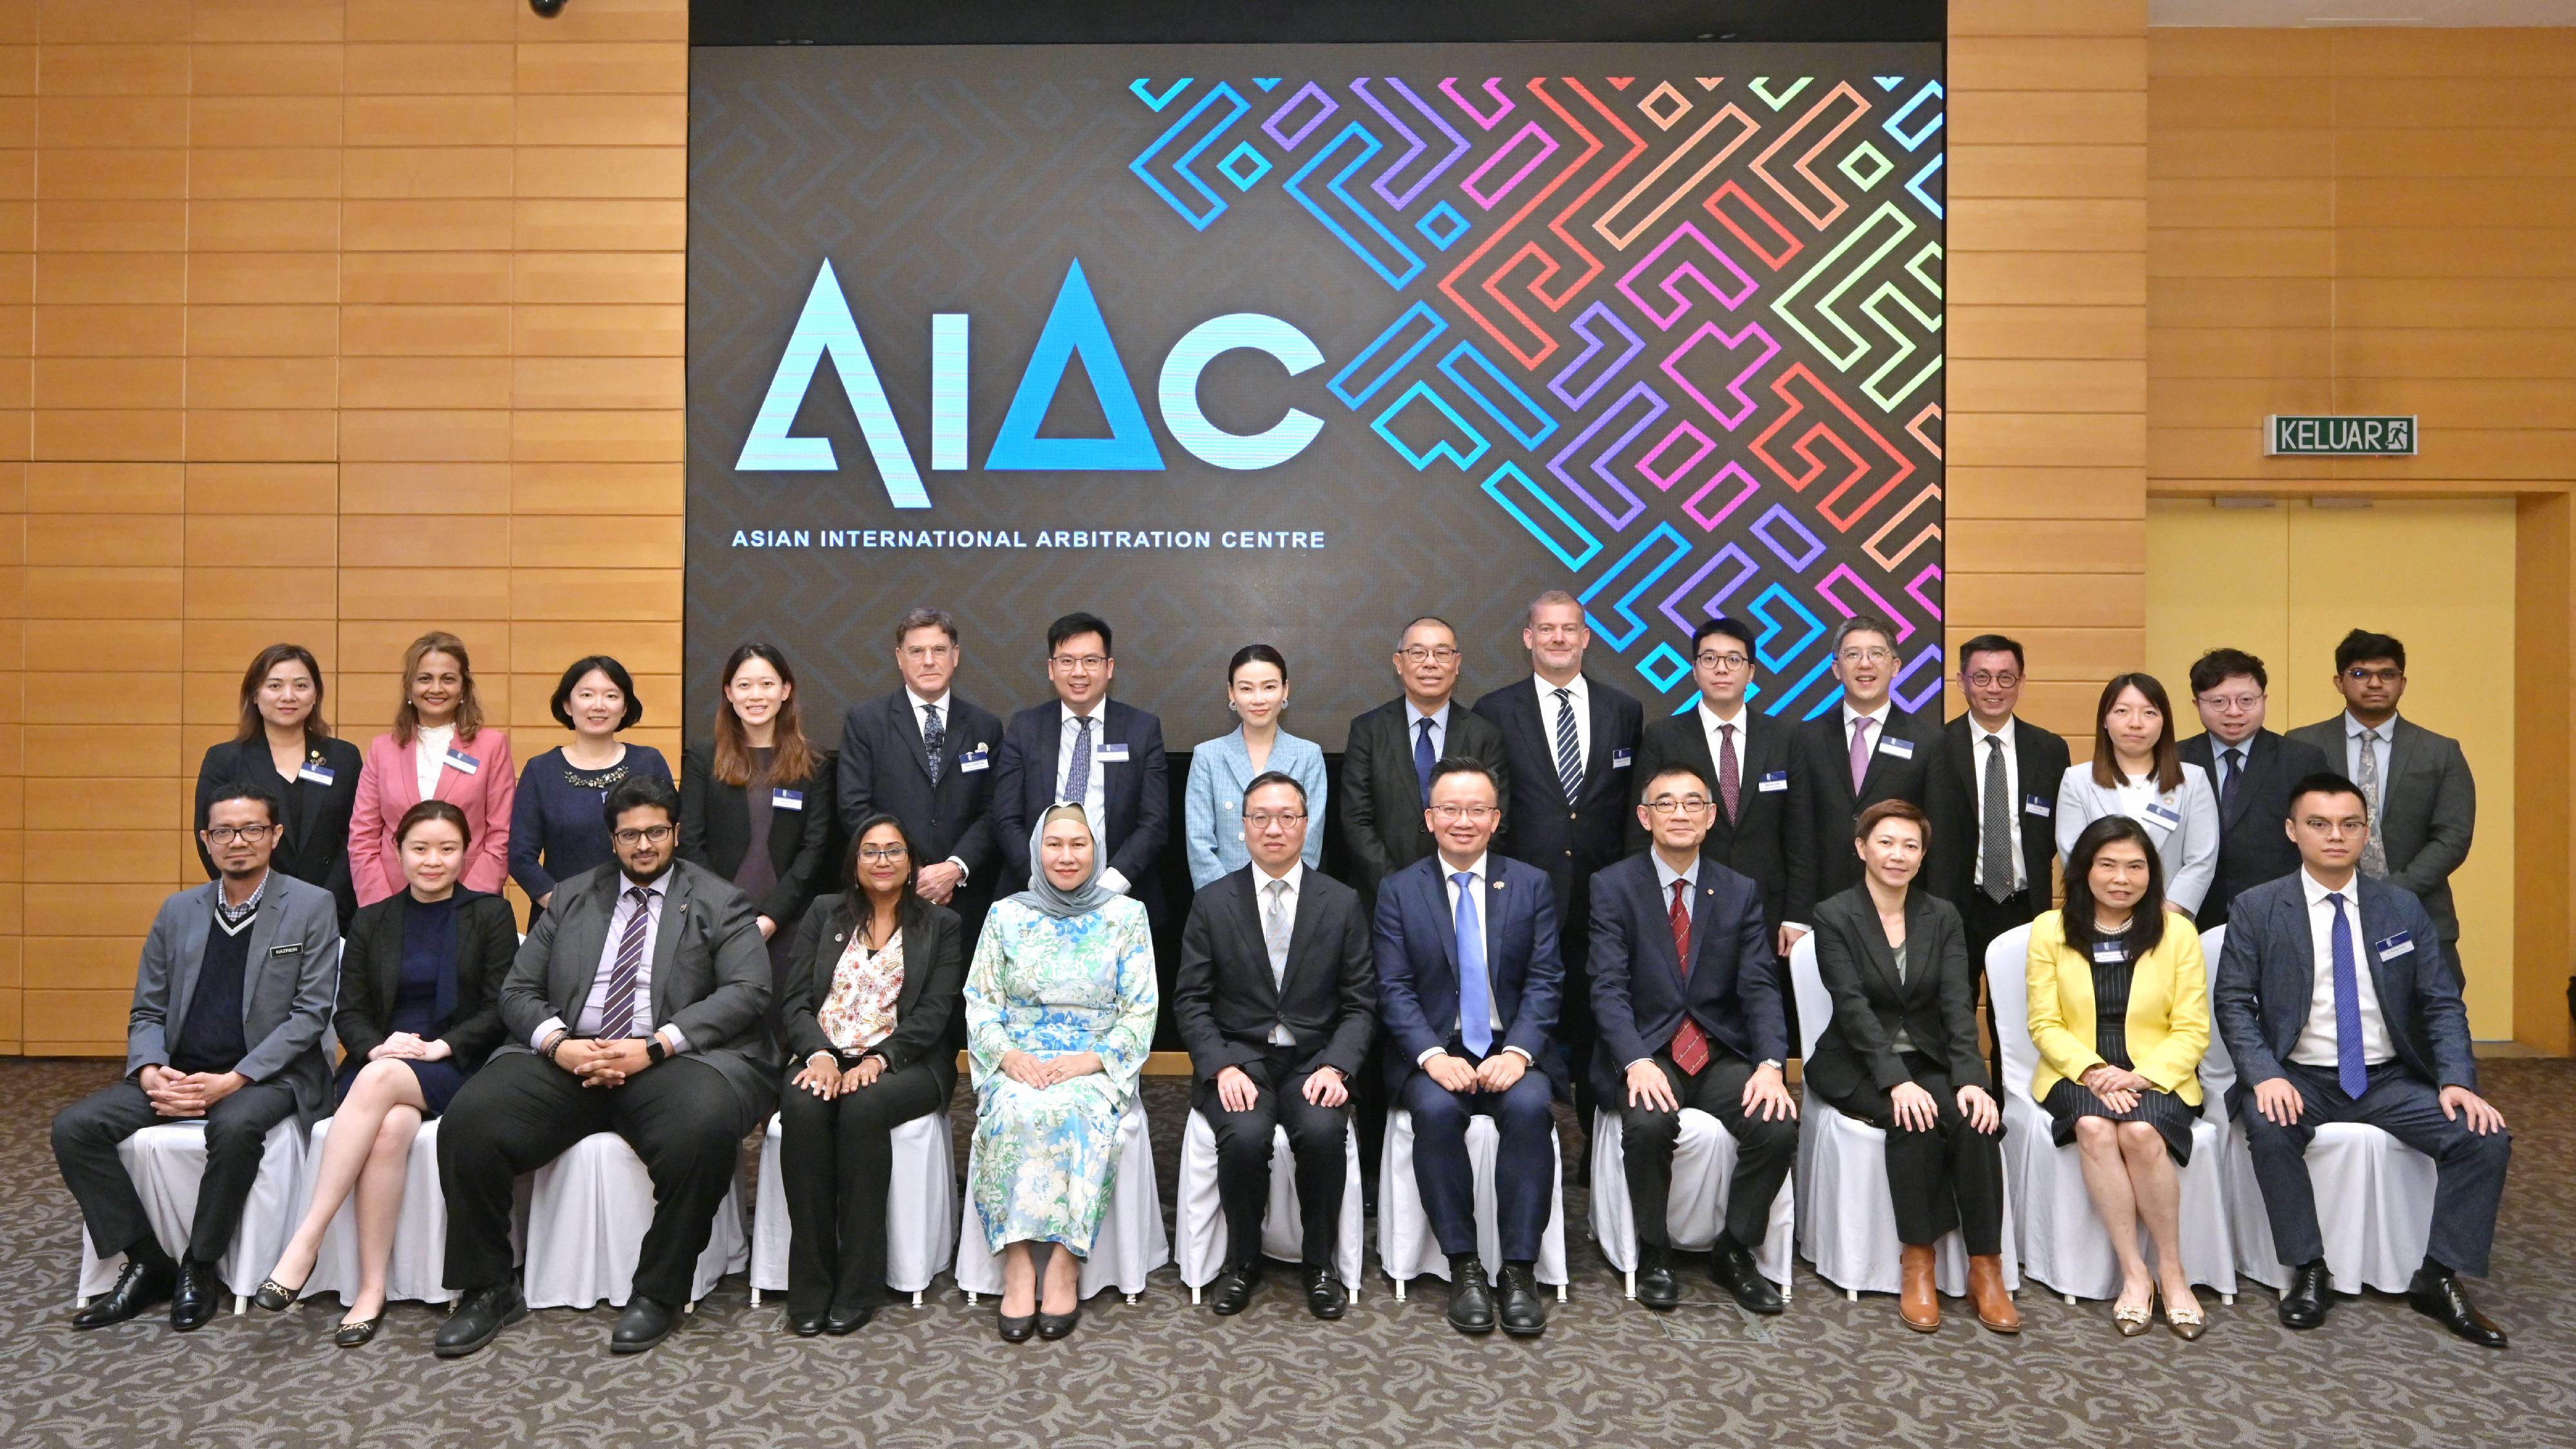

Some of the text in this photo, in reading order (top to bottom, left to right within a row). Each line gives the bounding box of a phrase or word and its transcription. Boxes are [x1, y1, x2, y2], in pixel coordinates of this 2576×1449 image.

[734, 256, 1326, 508] AIAC
[2282, 421, 2382, 450] KELUAR
[732, 530, 1325, 548] ASIAN INTERNATIONAL ARBITRATION CENTRE
